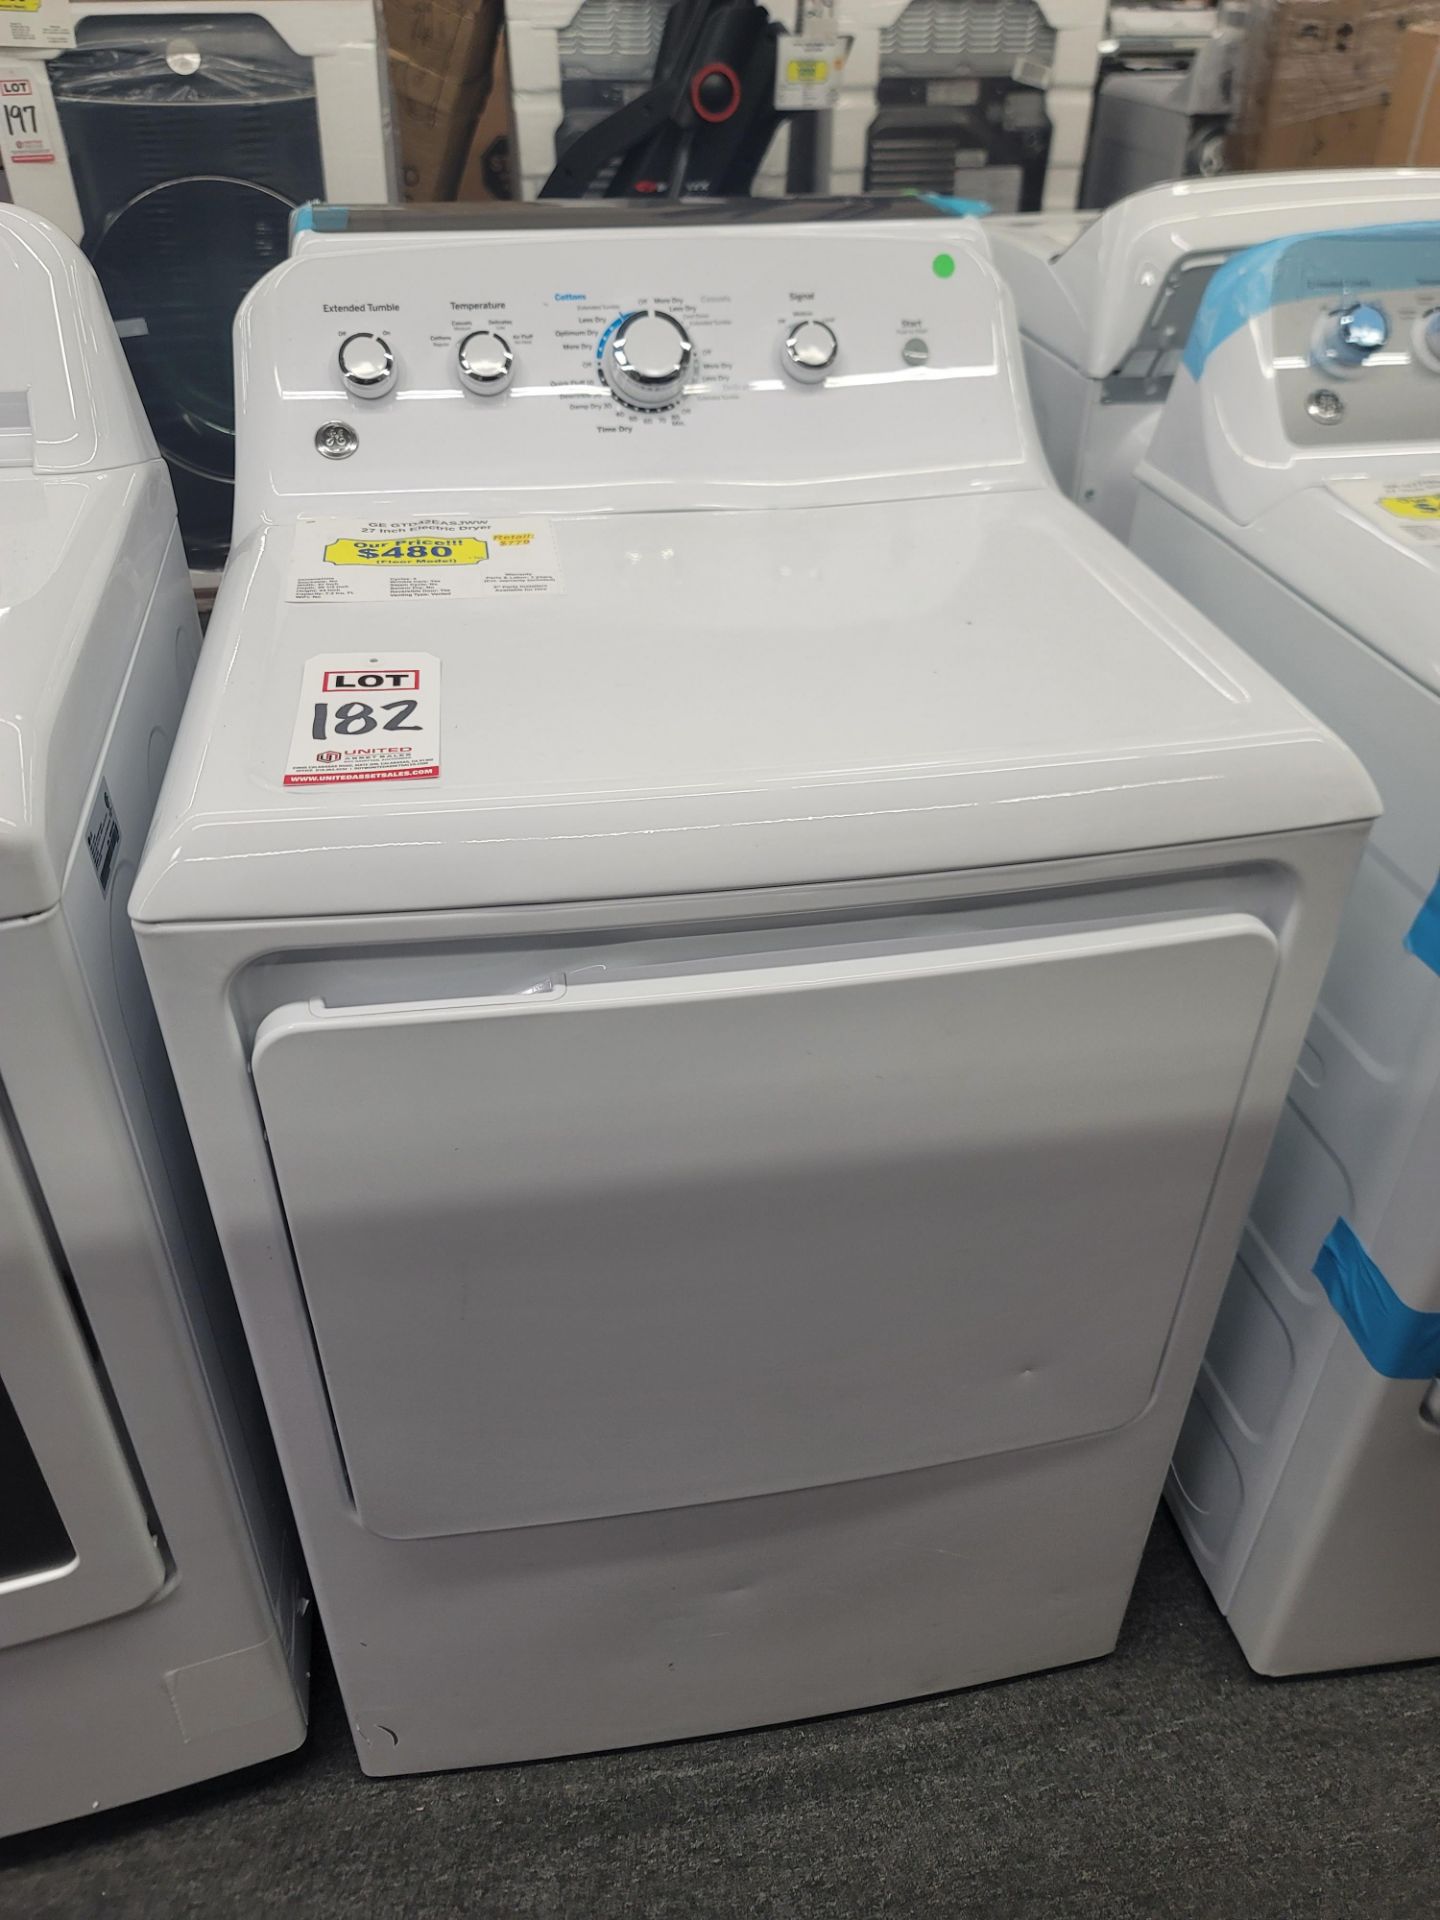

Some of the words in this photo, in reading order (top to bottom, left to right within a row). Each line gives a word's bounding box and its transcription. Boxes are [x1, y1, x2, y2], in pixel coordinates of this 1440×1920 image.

[4, 83, 27, 93] LOT
[4, 104, 37, 136] 197
[788, 292, 815, 302] Signal
[323, 304, 366, 313] Extended
[368, 304, 400, 312] Tumble
[450, 302, 506, 312] Temperature
[618, 425, 632, 434] Dry
[357, 546, 453, 559] $480
[336, 674, 409, 688] LOT
[312, 700, 424, 740] 182
[344, 747, 412, 755] UNITED
[290, 768, 433, 782] WWW.UNITEDASSETSALES.COM
